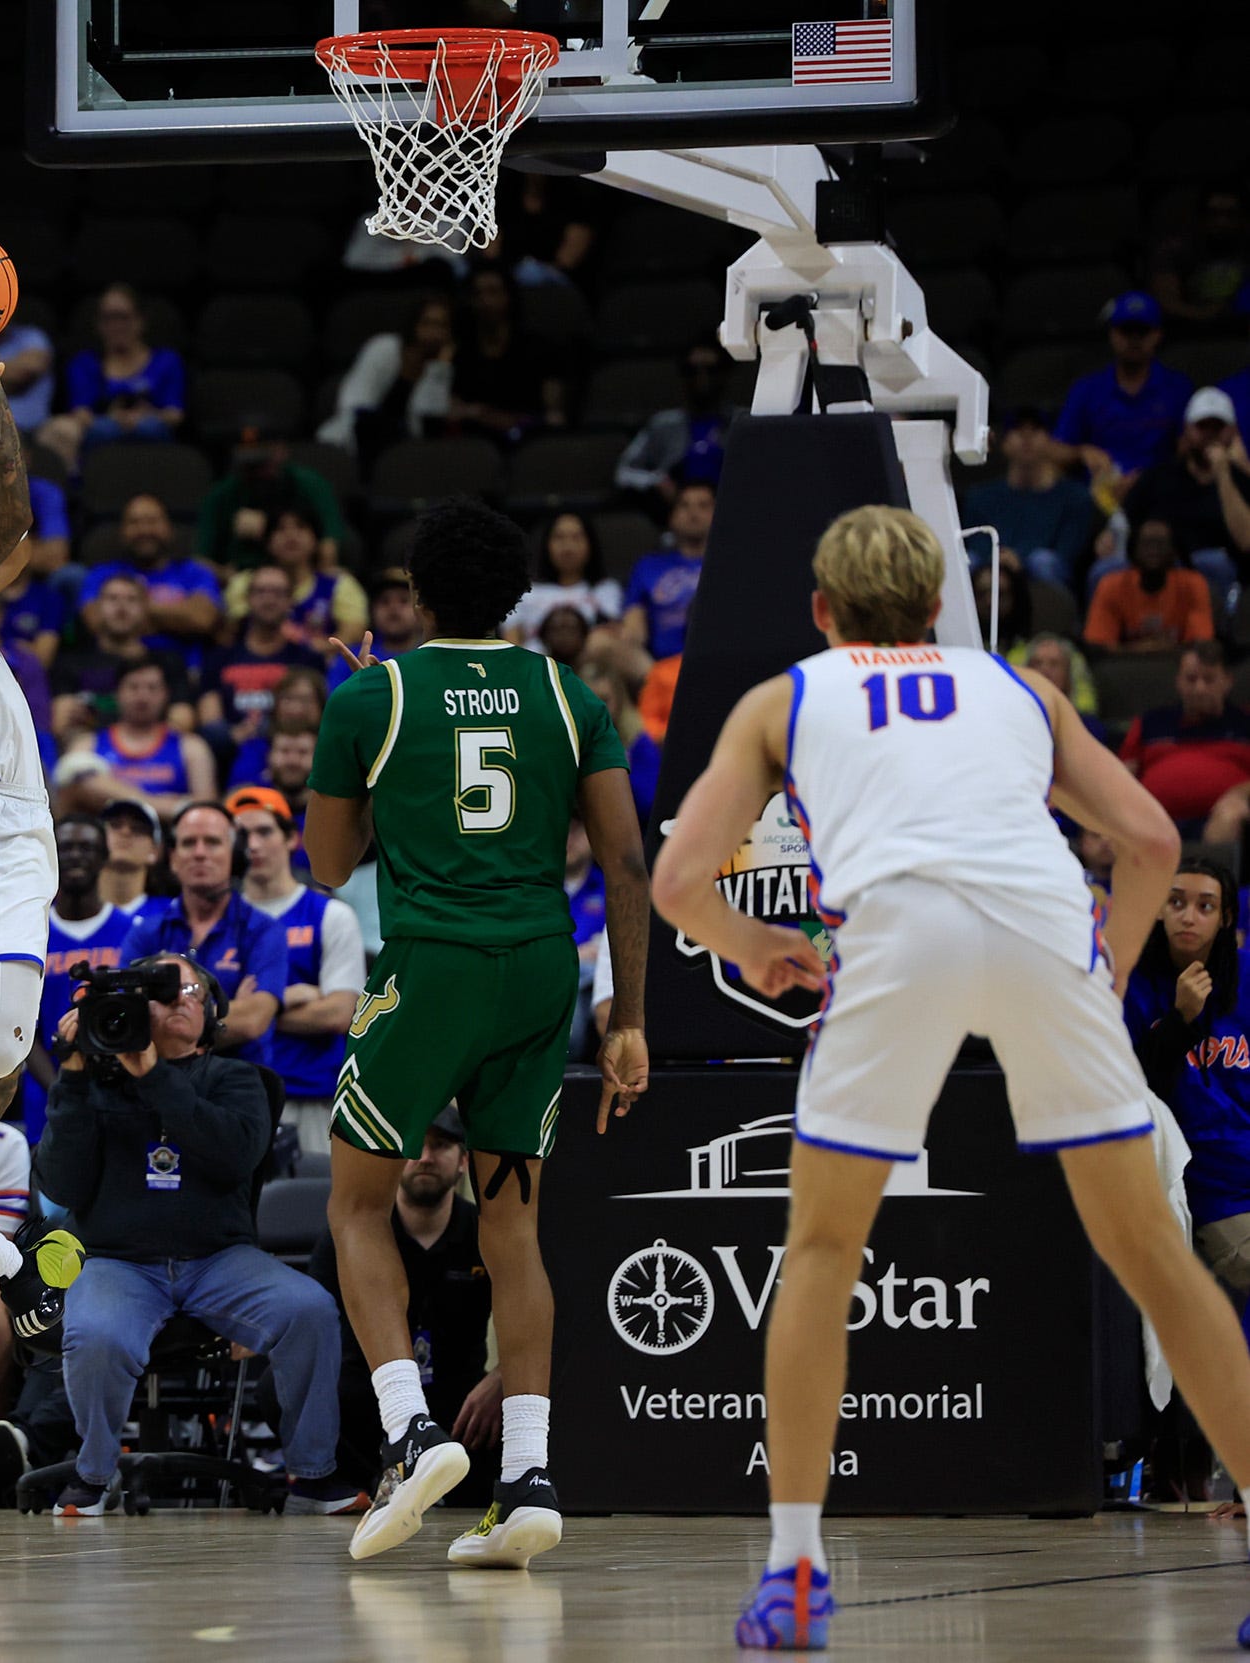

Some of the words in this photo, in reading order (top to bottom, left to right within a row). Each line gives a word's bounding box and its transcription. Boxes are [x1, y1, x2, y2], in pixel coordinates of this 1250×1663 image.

[849, 651, 945, 667] HAUGH
[444, 688, 520, 716] STROUD
[860, 671, 958, 732] 10
[453, 726, 517, 834] 5
[762, 835, 807, 844] JACKSO
[780, 844, 809, 853] SPOR
[716, 866, 814, 918] VITAT
[1186, 1034, 1250, 1070] ors
[619, 1295, 634, 1307] W
[693, 1295, 703, 1307] E
[712, 1246, 990, 1330] VStar
[657, 1332, 666, 1344] S
[620, 1385, 767, 1420] Veteran
[838, 1383, 983, 1420] emorial
